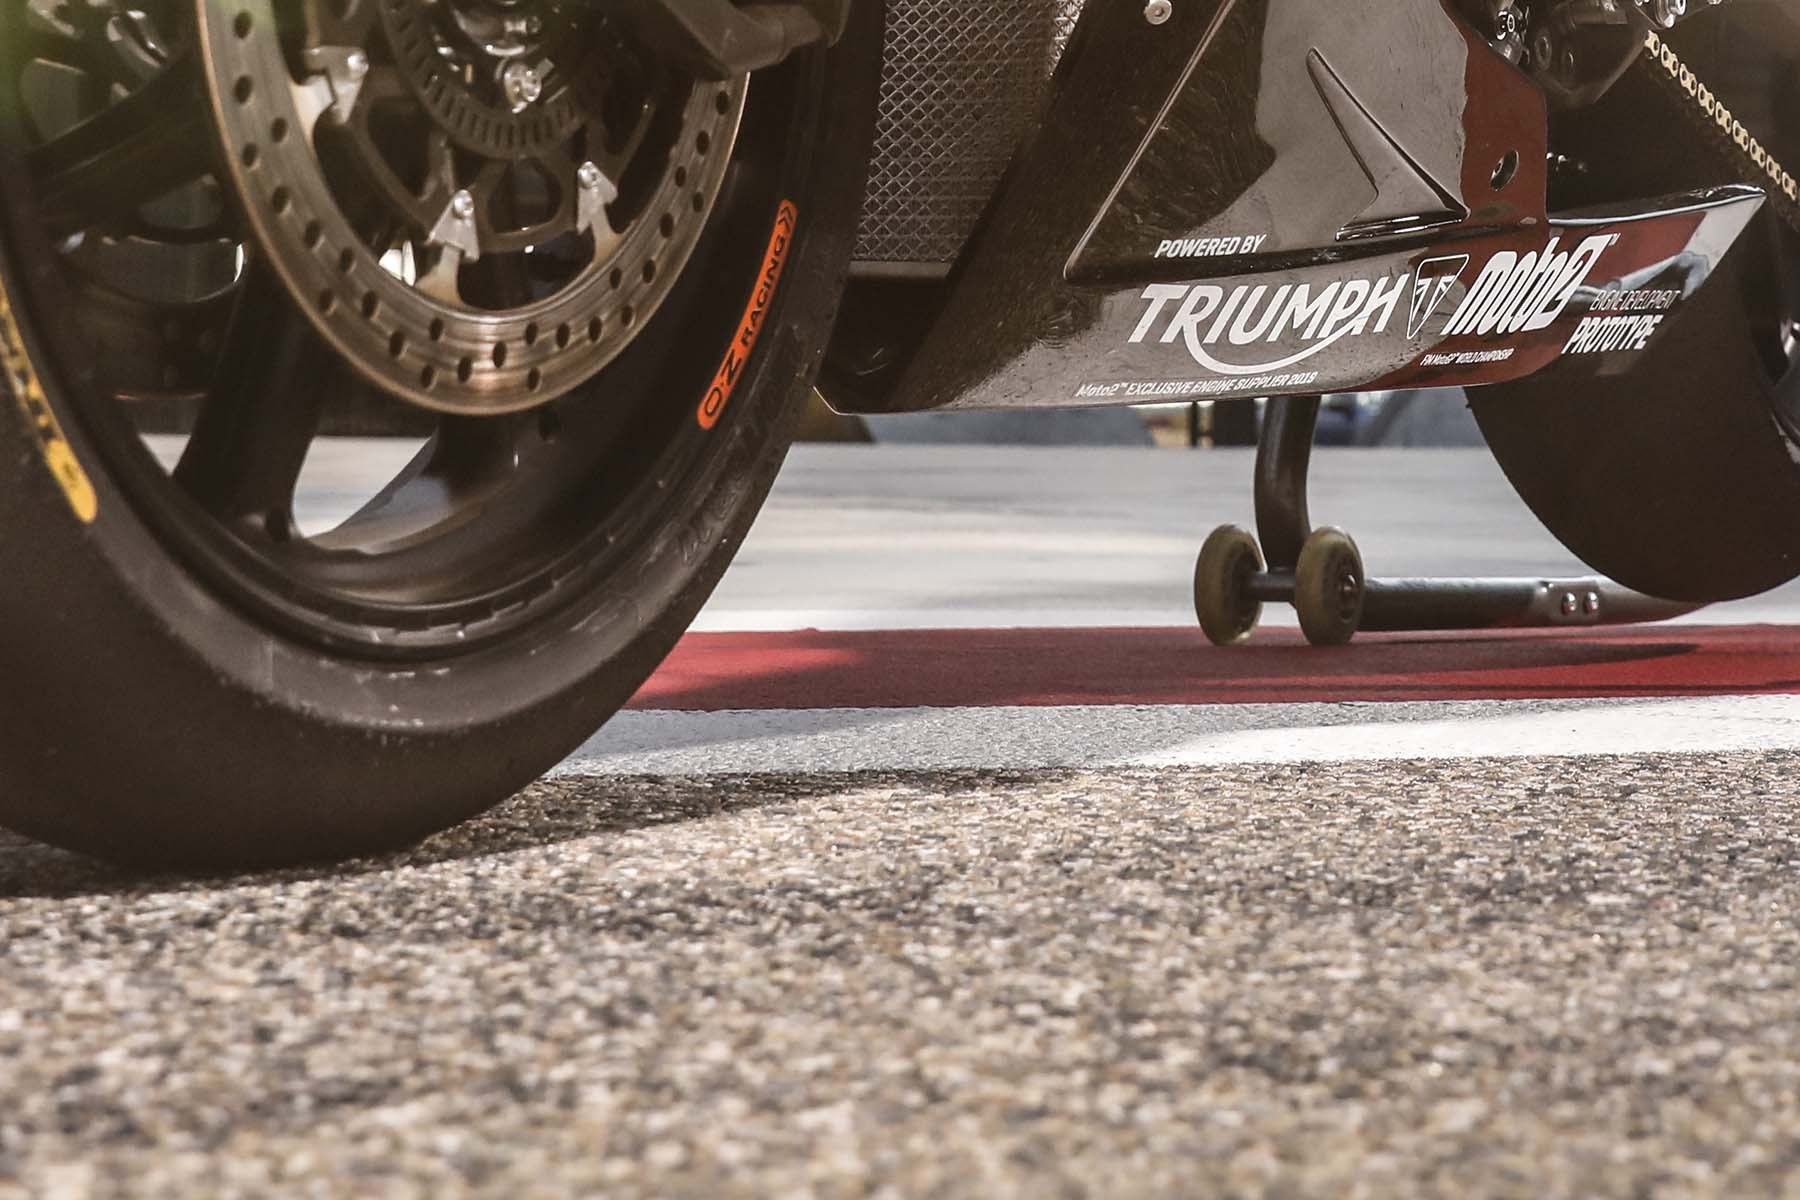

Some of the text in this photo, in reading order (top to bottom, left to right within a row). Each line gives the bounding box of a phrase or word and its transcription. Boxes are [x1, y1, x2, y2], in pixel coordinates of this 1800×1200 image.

[1154, 233, 1268, 259] POWERED BY
[741, 234, 786, 347] RACING
[1128, 272, 1411, 376] TRIUMPH
[1560, 314, 1664, 355] PROTOTYPE
[1125, 381, 1195, 396] EXCLUSIVE
[1190, 378, 1236, 394] ENGINE
[1233, 374, 1291, 391] SUPPLIER
